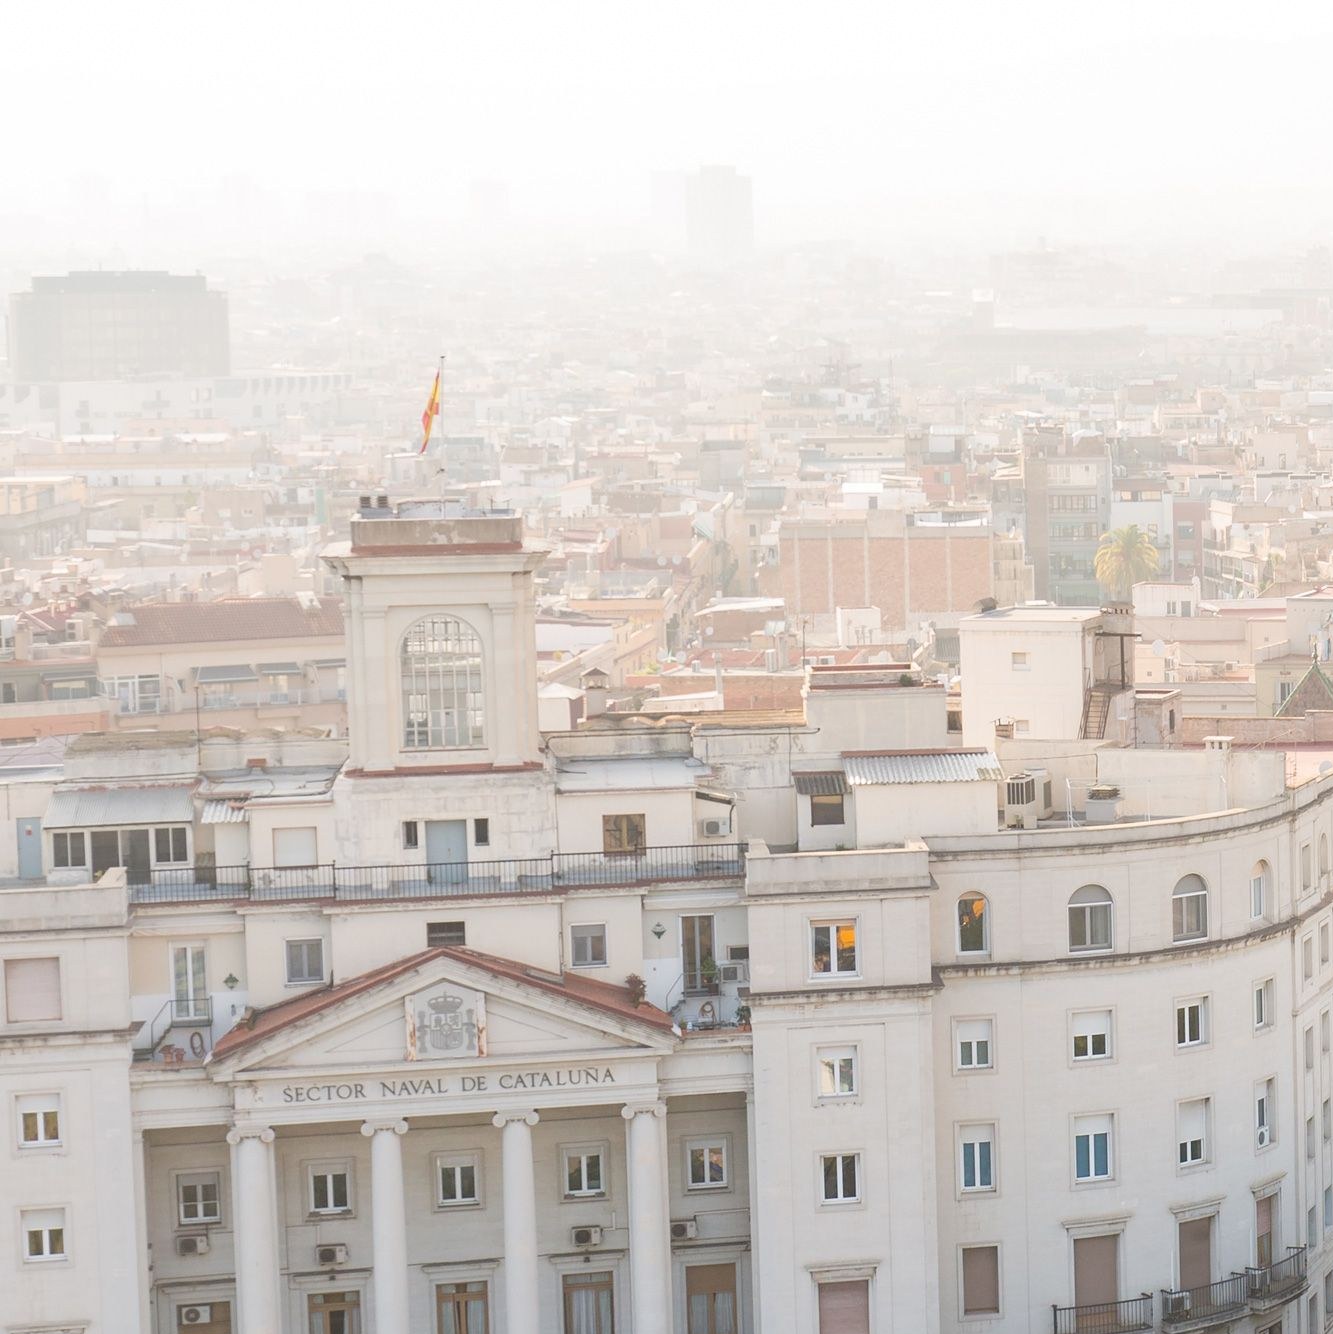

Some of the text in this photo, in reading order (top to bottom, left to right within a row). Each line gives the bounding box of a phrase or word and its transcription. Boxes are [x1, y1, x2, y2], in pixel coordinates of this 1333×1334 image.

[283, 1067, 616, 1103] SECTOR NAVAL DE CATALUÑA
